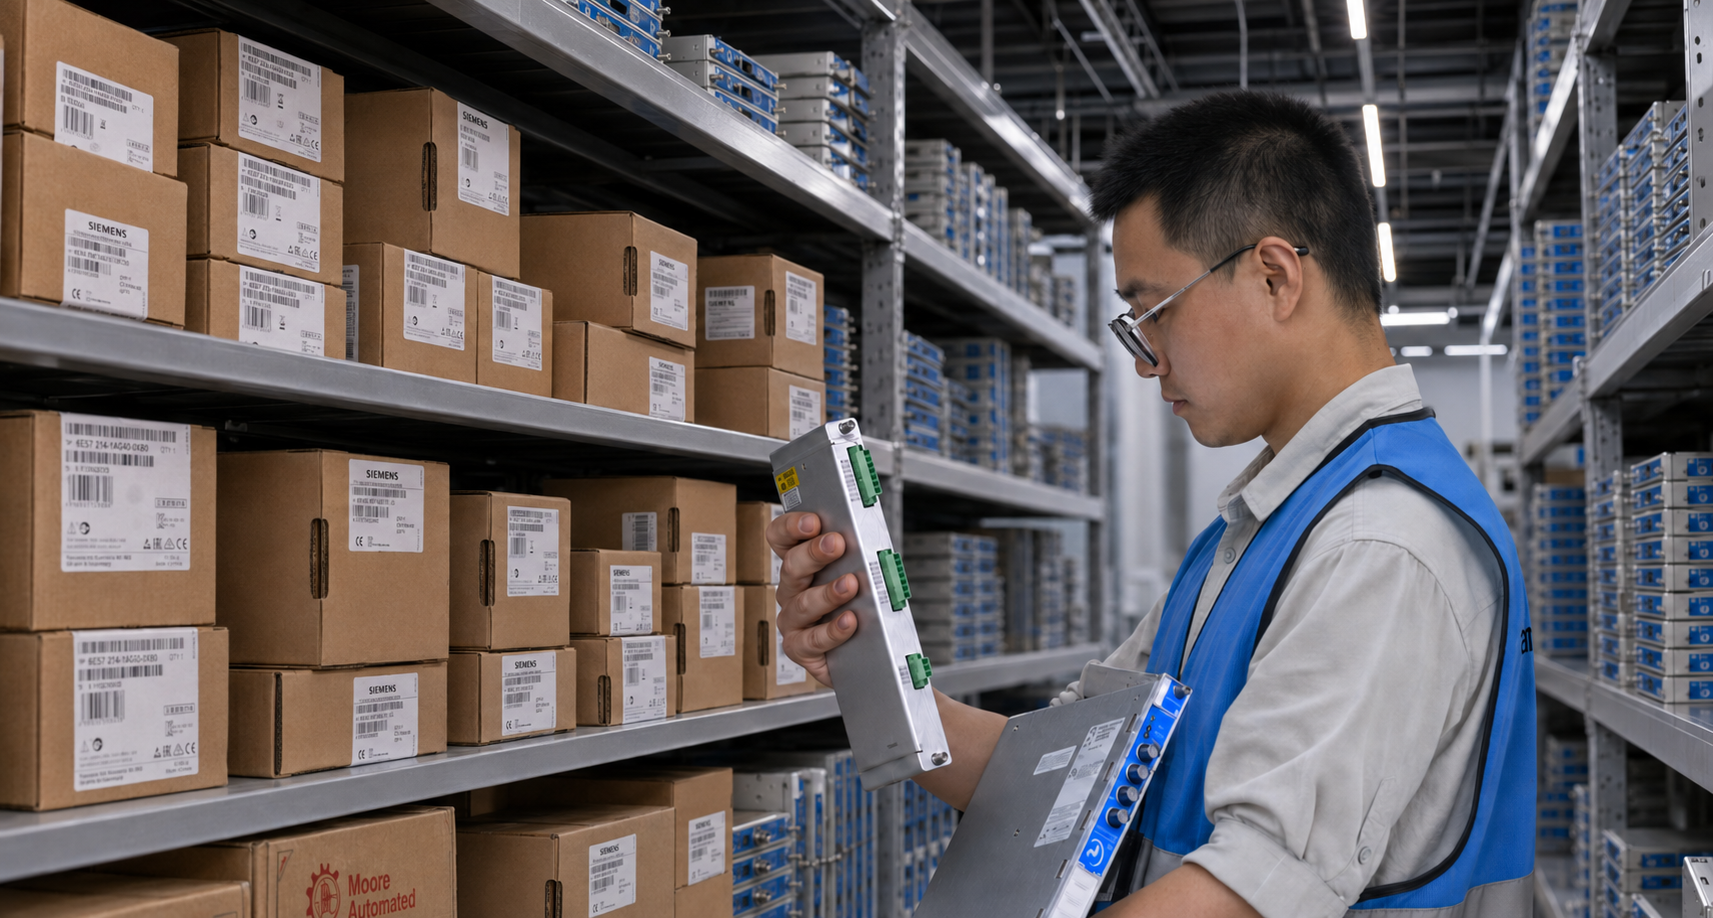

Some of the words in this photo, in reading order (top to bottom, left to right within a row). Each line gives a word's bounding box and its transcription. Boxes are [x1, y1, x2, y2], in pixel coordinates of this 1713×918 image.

[462, 111, 488, 129] SIEMENS
[88, 221, 127, 238] SIEMENS
[160, 446, 172, 454] QTY
[366, 469, 399, 481] SIEMENS
[515, 660, 537, 670] SIEMENS
[369, 684, 397, 695] SIEMENS
[348, 873, 390, 897] Moore
[348, 888, 416, 918] Automated
